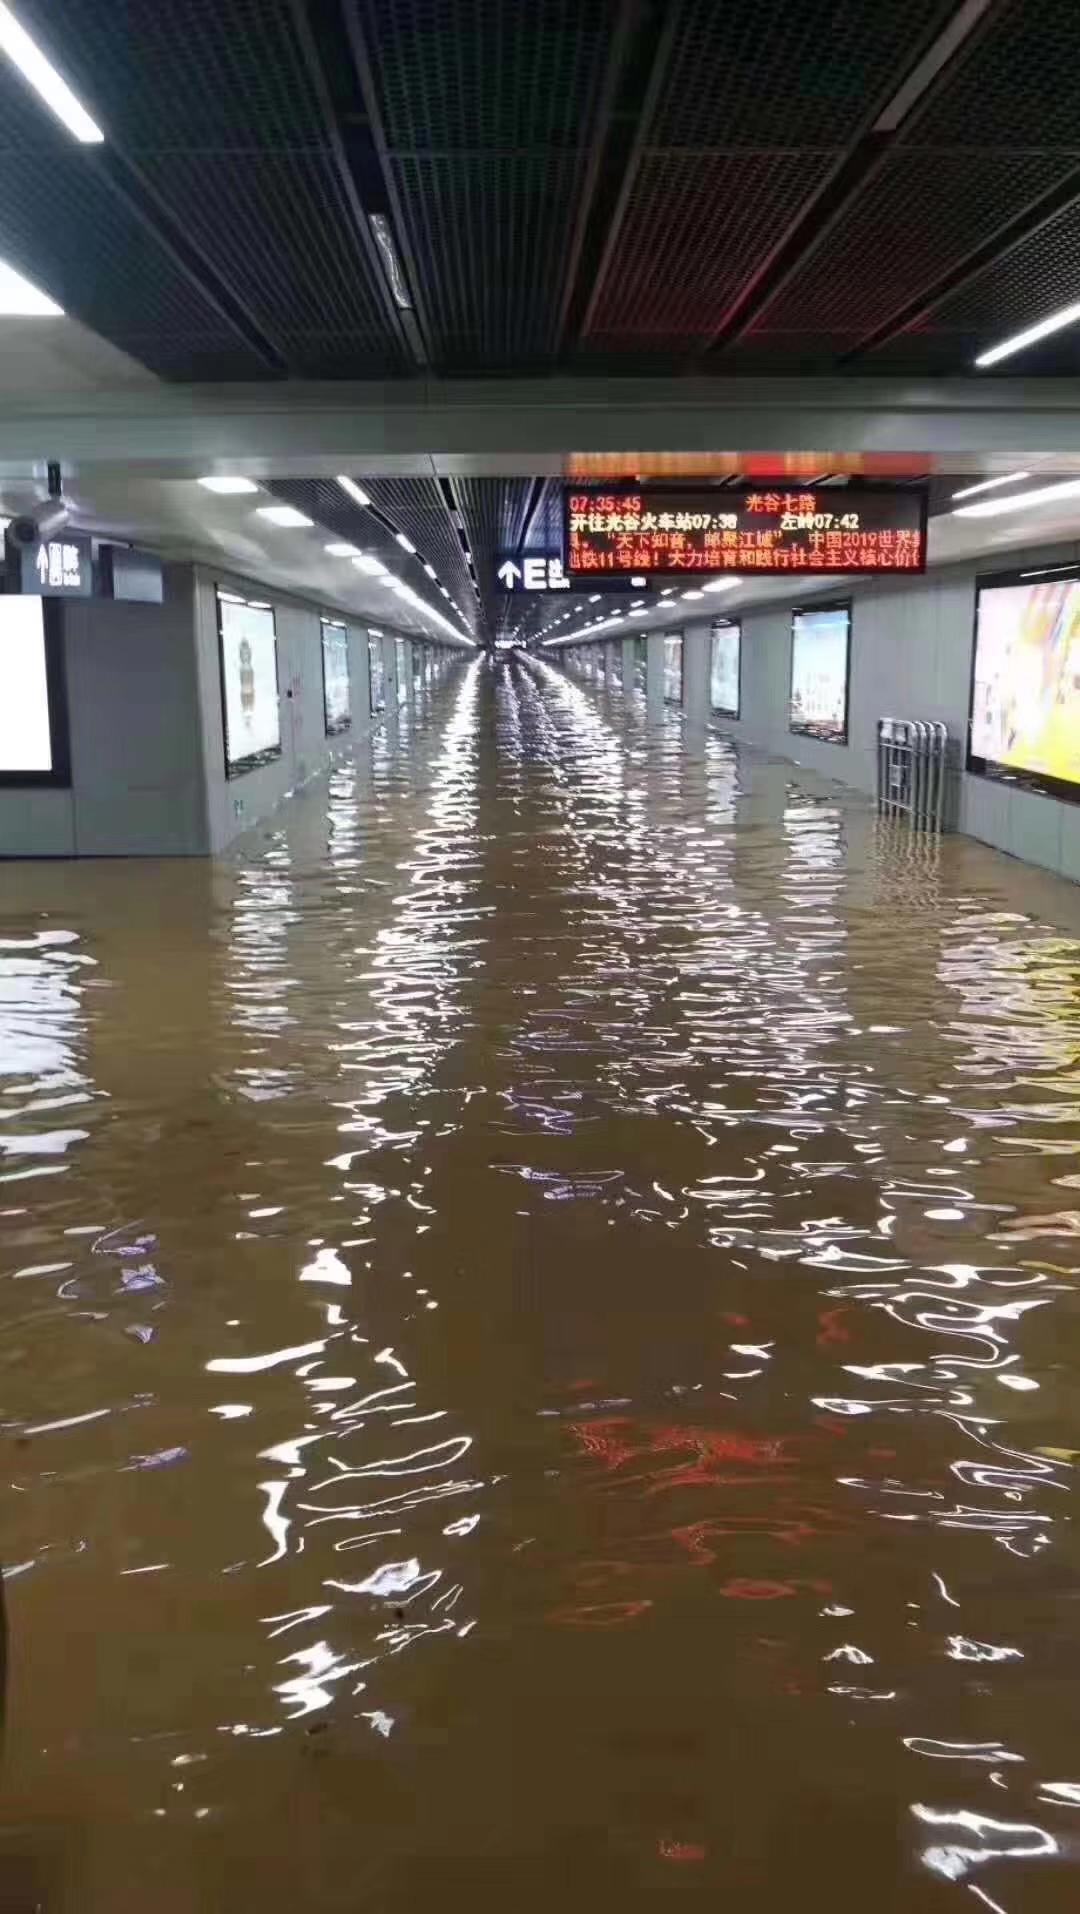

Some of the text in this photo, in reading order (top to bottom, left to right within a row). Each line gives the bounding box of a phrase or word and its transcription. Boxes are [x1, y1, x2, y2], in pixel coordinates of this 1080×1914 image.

[569, 496, 641, 512] 07:35:45
[745, 493, 817, 512] 光谷七路
[524, 558, 547, 589] E
